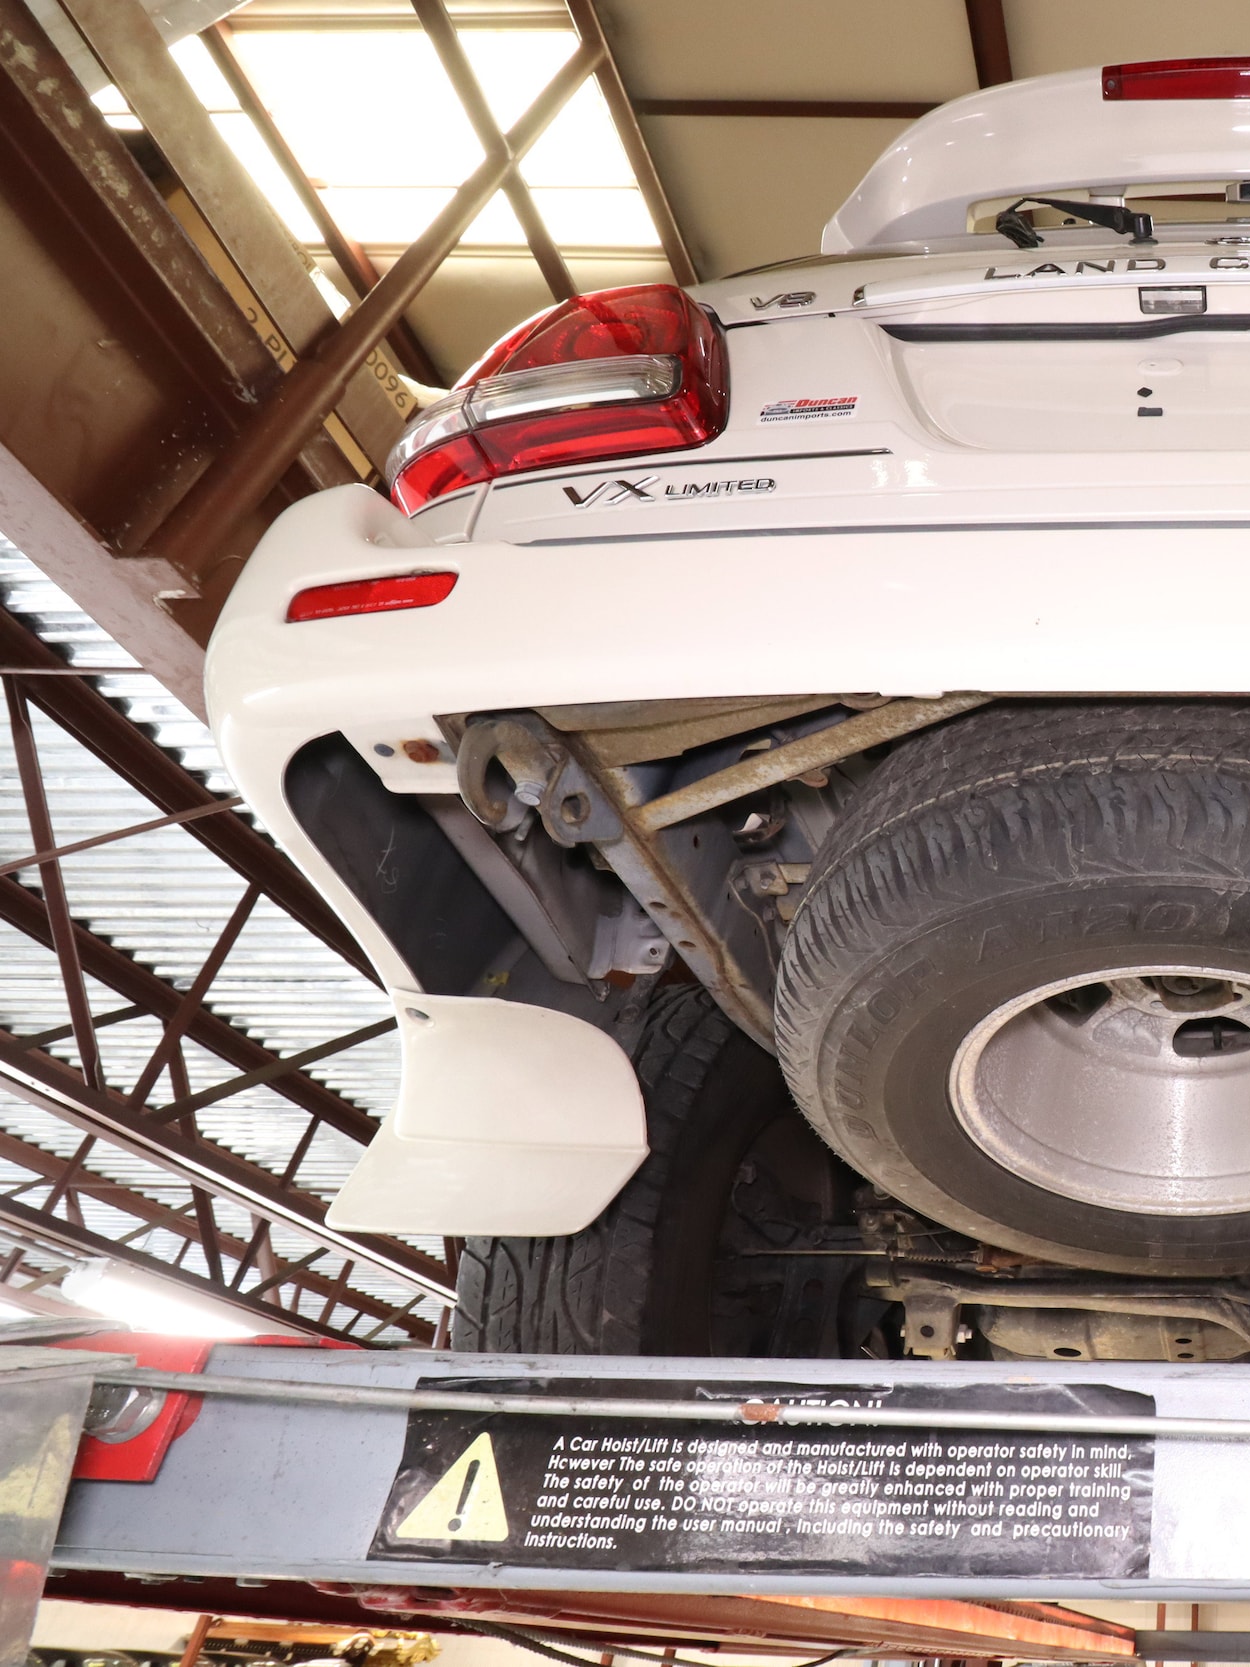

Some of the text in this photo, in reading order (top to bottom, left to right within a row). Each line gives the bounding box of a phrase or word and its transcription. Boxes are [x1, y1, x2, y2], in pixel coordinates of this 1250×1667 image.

[984, 258, 1166, 280] LAND
[750, 291, 817, 310] V8
[795, 396, 858, 407] Duncan
[760, 411, 851, 422] duncanimports.com
[562, 475, 776, 509] VX LIMITED
[553, 1436, 565, 1451] A
[569, 1436, 598, 1451] Car
[601, 1437, 669, 1455] Hoist/Lift
[671, 1438, 683, 1454] is
[687, 1439, 758, 1457] designed
[762, 1440, 793, 1456] and
[796, 1441, 906, 1457] manufactured
[911, 1442, 943, 1458] with
[947, 1444, 1016, 1461] operator
[1019, 1443, 1067, 1461] safety
[1071, 1444, 1085, 1459] in
[618, 1456, 645, 1472] The
[649, 1457, 682, 1472] safe
[686, 1459, 762, 1476] operation
[766, 1459, 784, 1475] of
[787, 1459, 812, 1475] the
[817, 1460, 886, 1477] Hoist/Lift
[889, 1461, 901, 1476] is
[905, 1461, 992, 1479] dependent
[996, 1466, 1016, 1478] on
[1020, 1464, 1090, 1480] operator
[542, 1473, 1131, 1500] The safety of the operator will be greatly enhanced with proper training
[536, 1493, 1100, 1520] and careful use. DO NOT operate this equipment without reading and
[530, 1512, 647, 1533] understanding
[651, 1514, 678, 1530] the
[682, 1518, 715, 1532] user
[720, 1518, 782, 1533] manual
[796, 1518, 873, 1538] including
[878, 1519, 905, 1535] the
[909, 1519, 961, 1539] safety
[970, 1521, 1002, 1537] and
[1012, 1522, 1130, 1541] precautionary
[523, 1532, 618, 1549] instructions.
